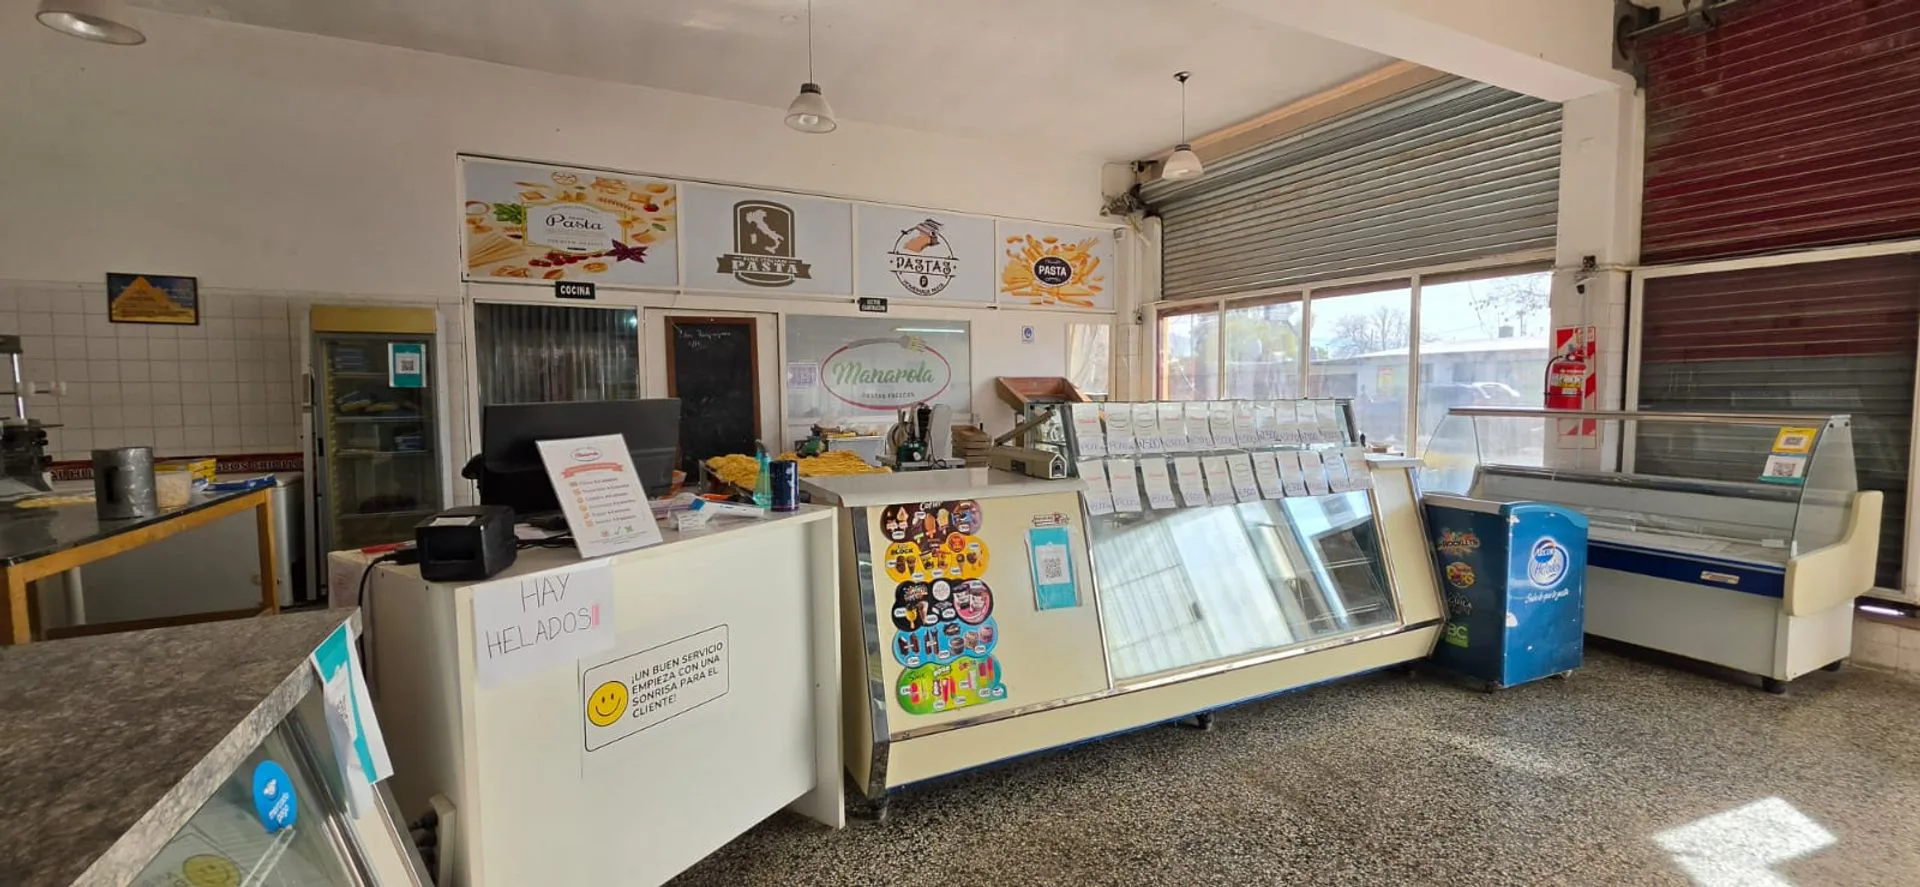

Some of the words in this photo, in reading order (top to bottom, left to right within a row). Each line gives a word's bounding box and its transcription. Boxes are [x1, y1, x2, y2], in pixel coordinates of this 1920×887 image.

[546, 213, 604, 230] Pasta
[732, 260, 798, 274] PASTA
[896, 256, 952, 275] PASTAS
[1038, 264, 1067, 277] PASTA
[560, 285, 590, 296] COCINA
[832, 360, 935, 385] Manarola
[520, 573, 570, 612] HAY
[484, 607, 592, 659] HELADOS
[632, 668, 650, 684] ¡UN
[652, 657, 680, 675] BUEN
[681, 642, 723, 663] SERVICIO
[632, 671, 676, 694] EMPIEZA
[678, 662, 699, 676] CON
[700, 655, 720, 668] UNA
[632, 682, 677, 706] SONRISA
[680, 671, 706, 687] PARA
[708, 666, 719, 676] EL
[632, 694, 677, 718] CLIENTE!
